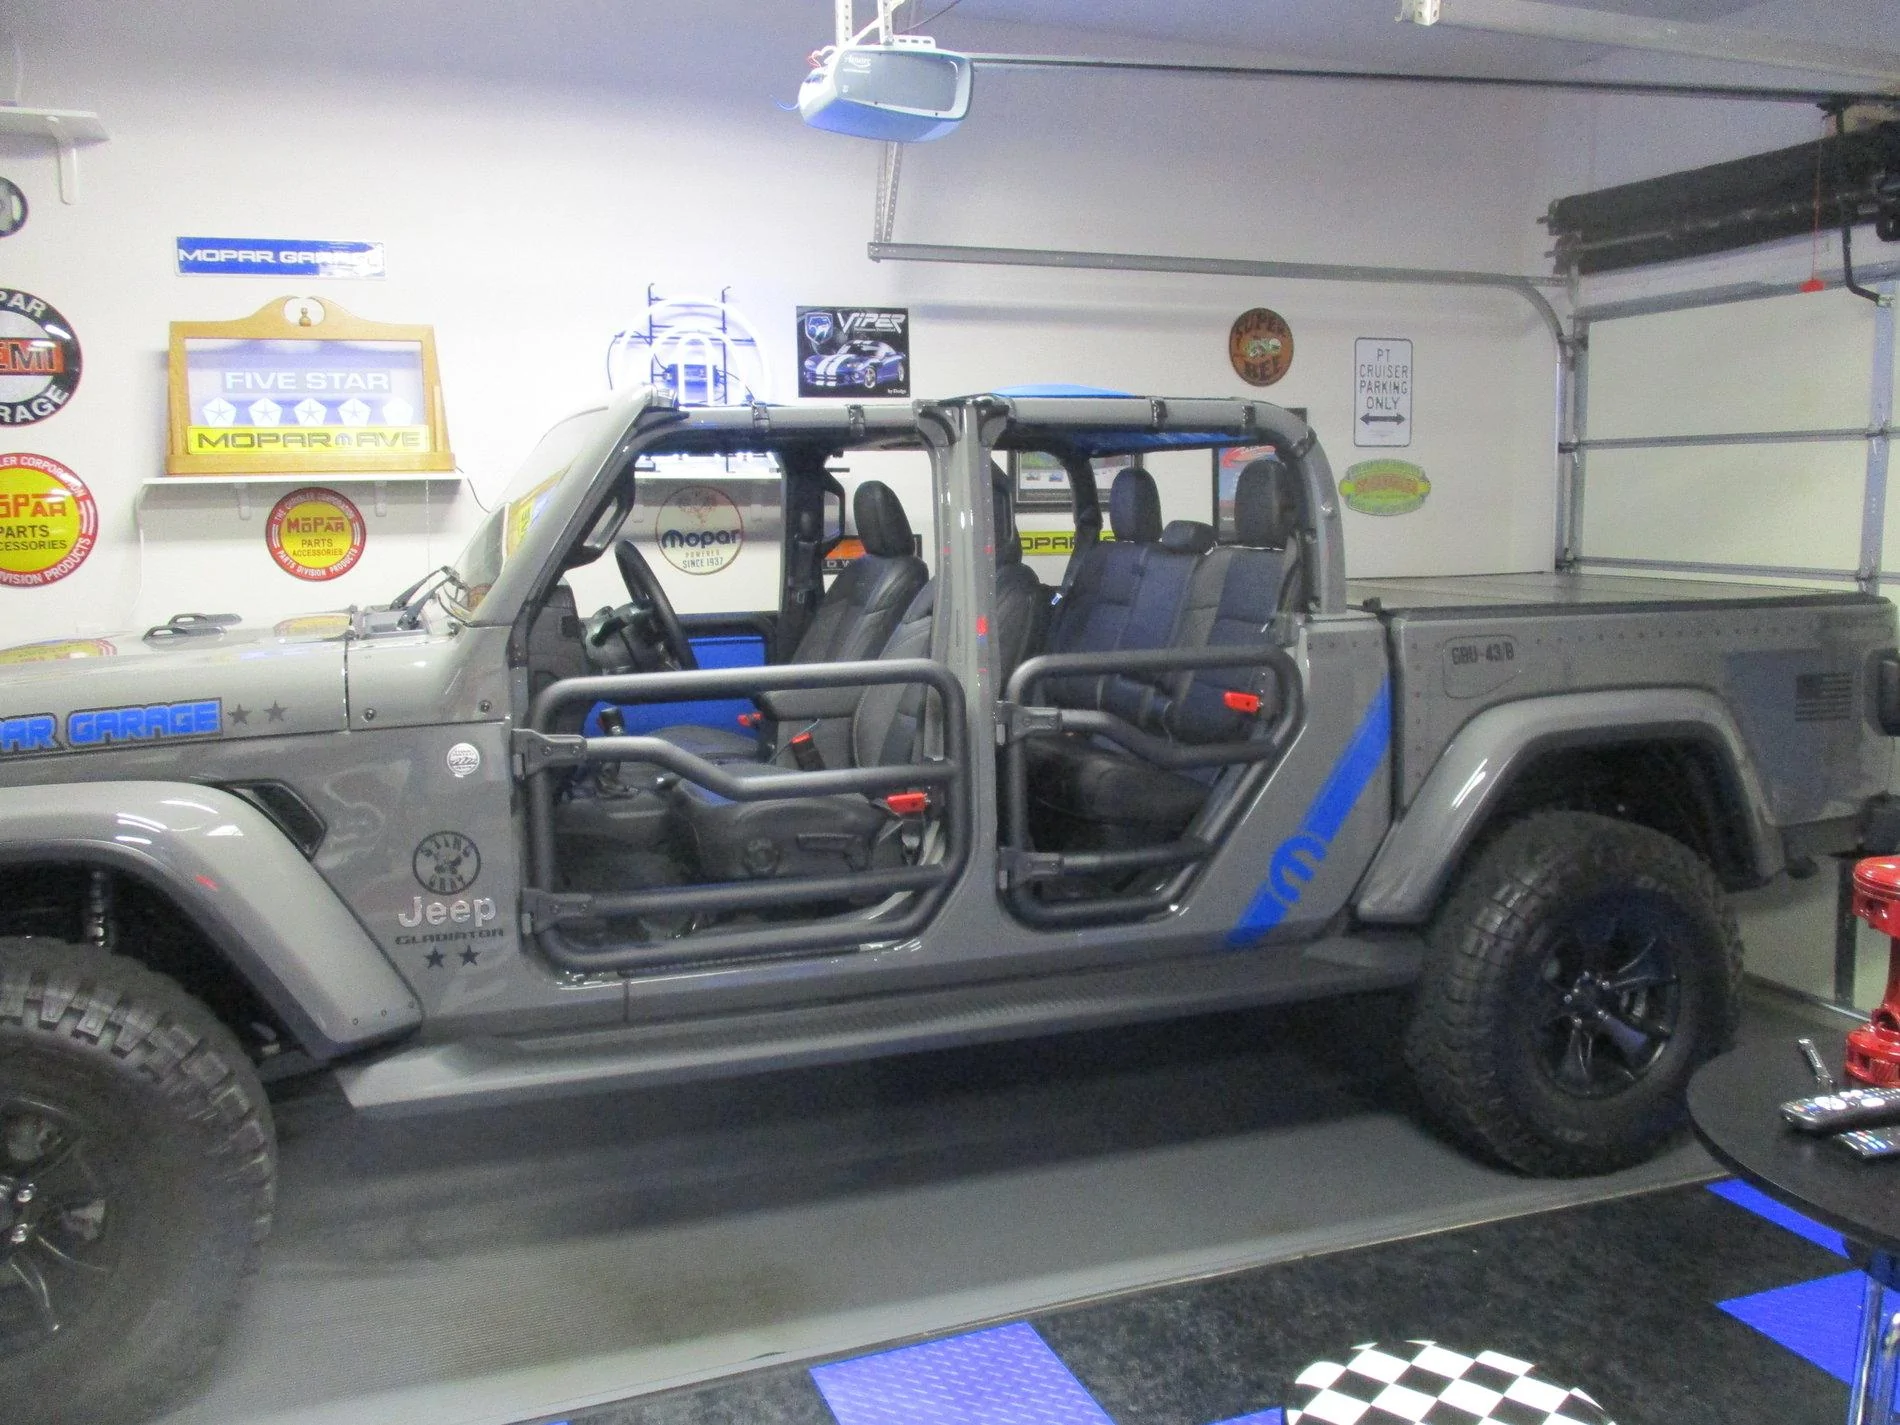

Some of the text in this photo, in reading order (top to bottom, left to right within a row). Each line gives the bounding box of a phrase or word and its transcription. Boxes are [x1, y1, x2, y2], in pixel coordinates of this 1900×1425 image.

[178, 249, 276, 264] MOPAR
[837, 312, 906, 334] VIPER
[1376, 348, 1391, 362] PT
[1359, 364, 1408, 379] CRUISER
[224, 371, 389, 390] FIVE STAR
[1359, 380, 1408, 395] PARKING
[1366, 396, 1400, 410] ONLY
[197, 431, 421, 449] MOPAR AVE
[301, 538, 333, 548] PARTS
[44, 537, 91, 581] PRODUCTS
[292, 548, 343, 557] ACCESSORIES
[277, 548, 358, 577] PARTS DIVISION PRODUCTS
[682, 557, 724, 569] SINCE 1937
[68, 700, 222, 747] GARAGE
[398, 896, 497, 928] Jeep
[394, 928, 504, 945] GLADIATOR
